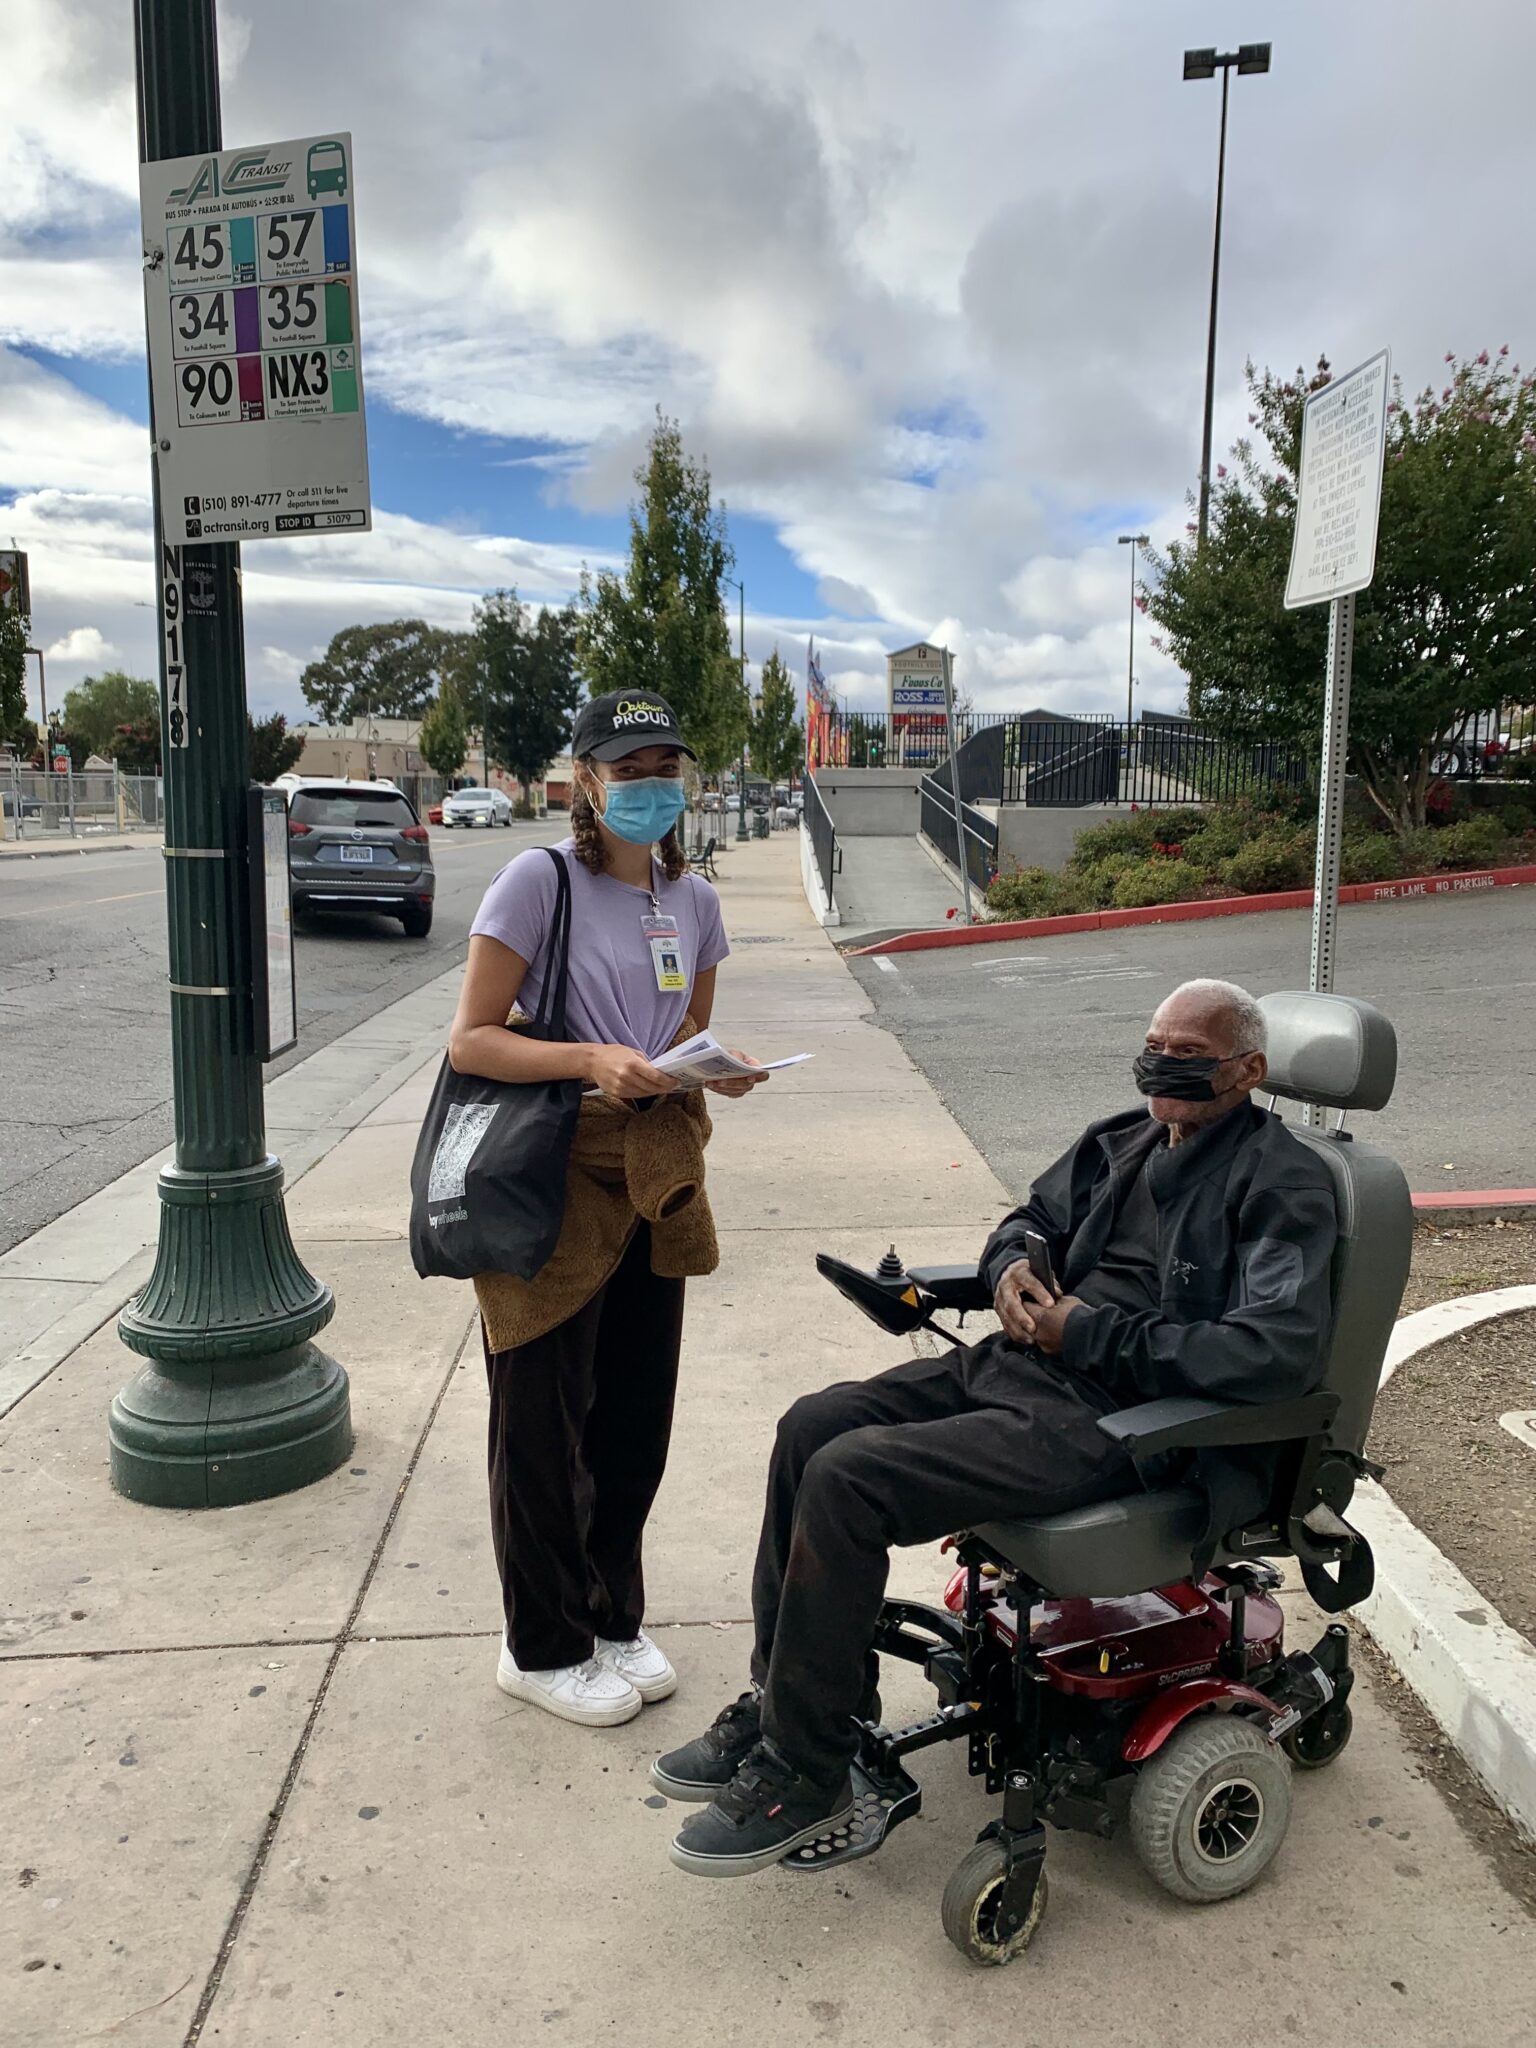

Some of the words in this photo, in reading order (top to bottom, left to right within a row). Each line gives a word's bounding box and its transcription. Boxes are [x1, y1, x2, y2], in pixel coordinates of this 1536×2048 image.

[240, 162, 292, 180] TRANSIT
[165, 211, 177, 219] BUS
[178, 209, 192, 218] STOP
[198, 205, 221, 216] PARADA
[222, 203, 231, 212] DE
[267, 211, 316, 261] 57
[174, 224, 224, 270] 45
[267, 284, 317, 331] 35
[178, 293, 229, 340] 34
[298, 333, 316, 342] Square
[268, 351, 329, 400] NX3
[1364, 366, 1381, 383] PARKED
[182, 362, 233, 408] 90
[1348, 386, 1374, 408] ACCESSIBLE
[217, 410, 231, 418] BART
[286, 489, 296, 498] Or
[298, 488, 309, 497] call
[311, 487, 322, 496] 511
[324, 486, 334, 495] for
[336, 485, 348, 495] live
[202, 496, 227, 512] (510)
[231, 492, 282, 509] 891-4777
[287, 499, 321, 510] departure
[322, 497, 339, 507] times
[203, 518, 270, 535] actransit.org
[279, 518, 300, 529] STOP
[302, 517, 311, 527] ID
[327, 514, 351, 524] 51079
[1308, 563, 1331, 576] OAKLAND
[894, 691, 924, 703] ROSS
[616, 701, 664, 716] Oaktown
[612, 710, 670, 730] PROUD
[1374, 887, 1397, 900] FIRE
[1401, 883, 1427, 897] LANE
[1436, 881, 1450, 892] NO
[1453, 876, 1495, 891] PARKING
